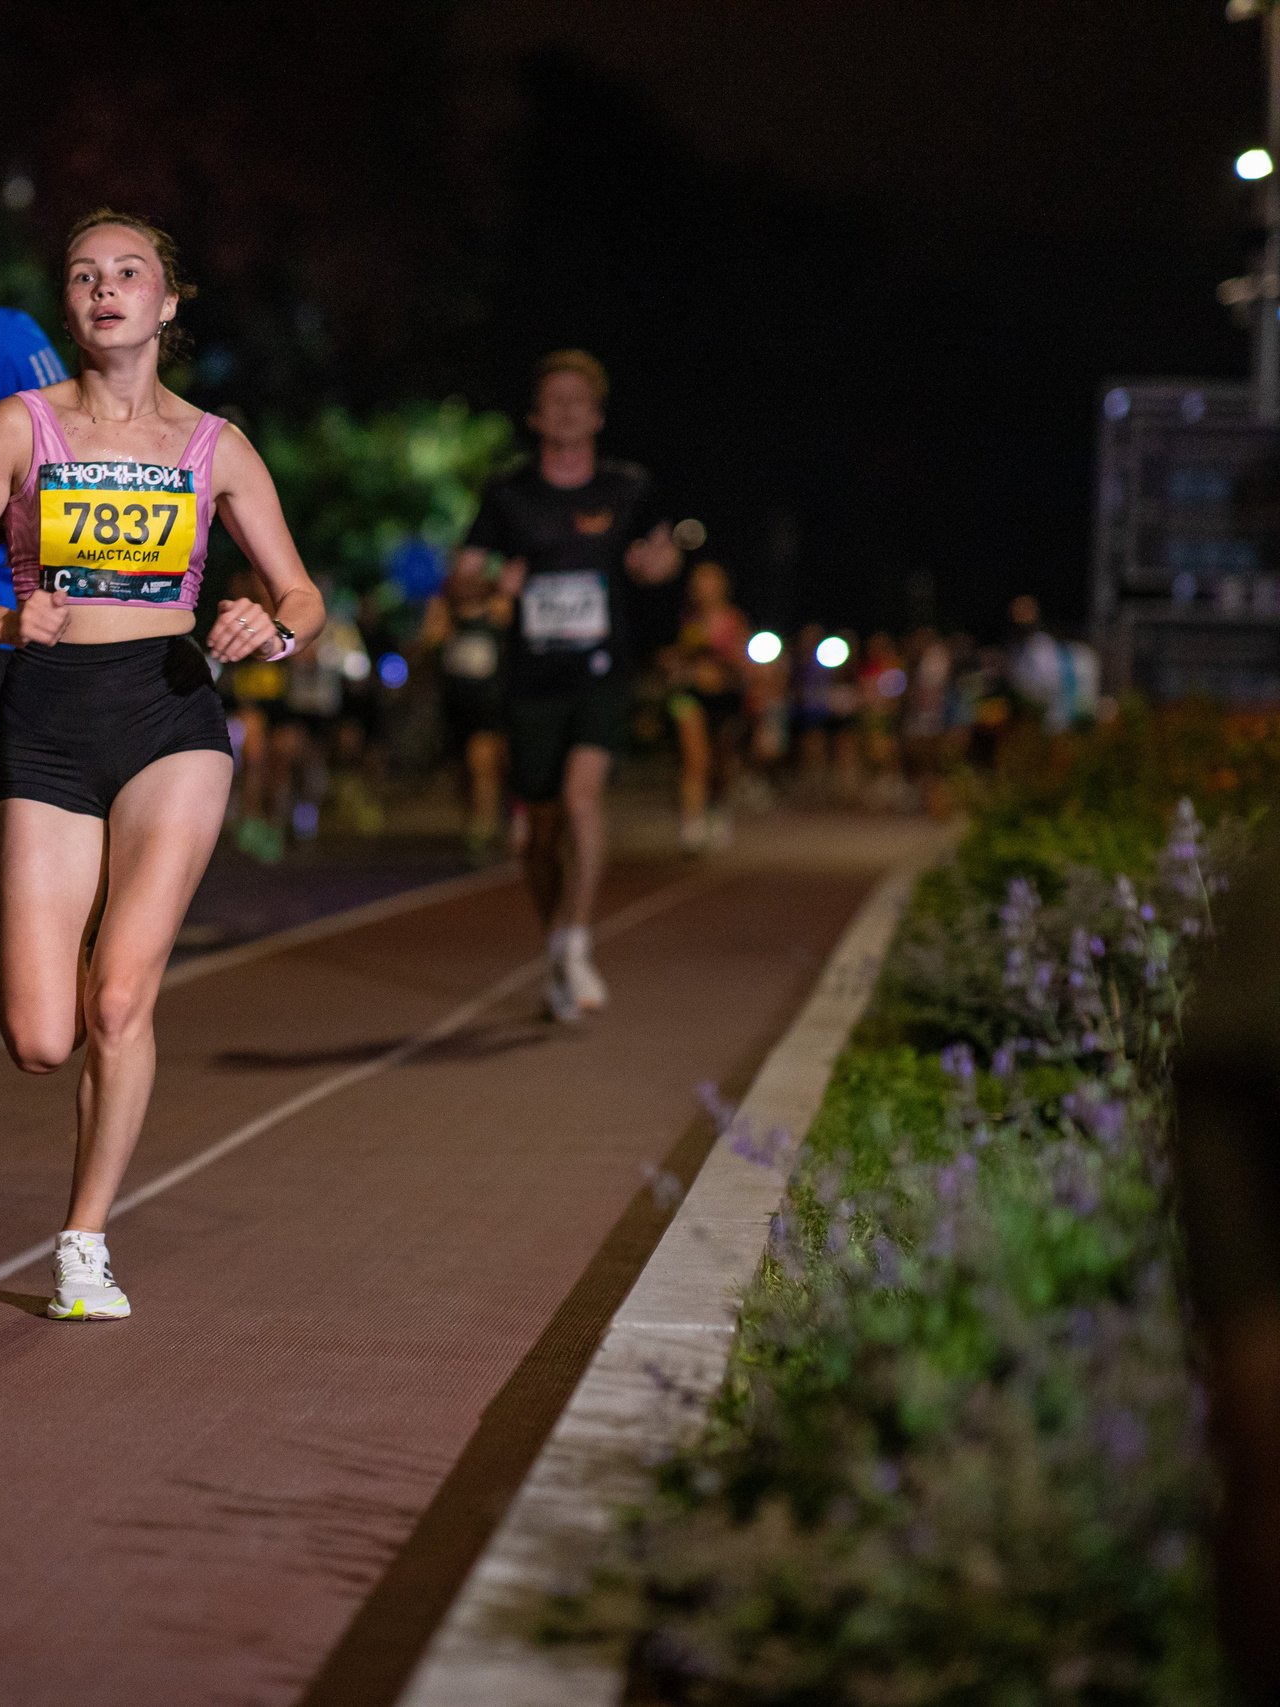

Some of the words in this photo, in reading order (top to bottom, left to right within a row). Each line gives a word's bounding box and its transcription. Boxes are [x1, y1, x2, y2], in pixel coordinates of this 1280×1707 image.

[57, 463, 182, 488] НОЧНОЙ
[64, 502, 179, 546] 7837
[77, 549, 160, 562] АНАСТАСИЯ
